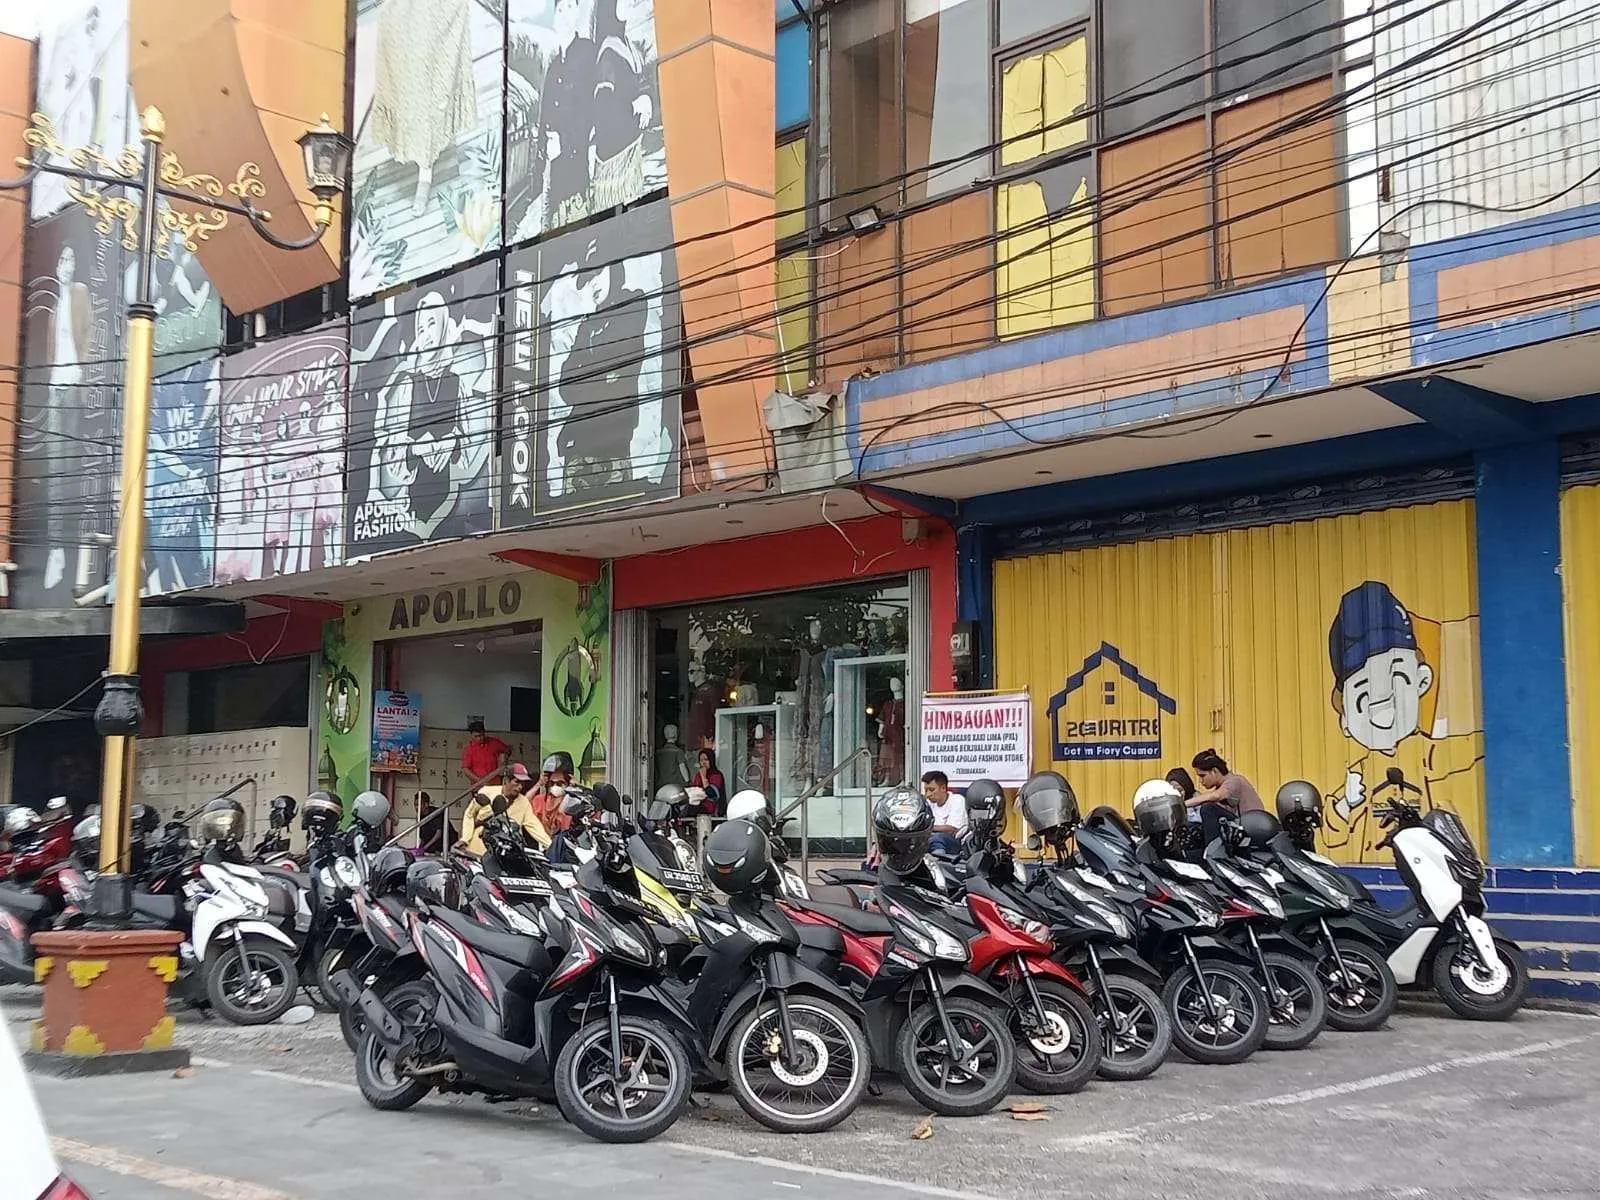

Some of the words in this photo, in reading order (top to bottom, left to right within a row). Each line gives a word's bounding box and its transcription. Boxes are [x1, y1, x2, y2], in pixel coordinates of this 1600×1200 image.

[512, 268, 535, 372] NEW
[166, 402, 196, 428] WE
[354, 498, 411, 523] APOLLO
[354, 510, 416, 541] FASHION
[389, 580, 522, 631] APOLLO
[377, 706, 410, 716] LANTAI
[924, 708, 1023, 730] HIMBAUAN!!!
[936, 744, 958, 752] LARANG
[1000, 743, 1015, 751] AREA
[987, 733, 1001, 741] LIMA
[922, 755, 939, 763] TERAS
[940, 755, 955, 763] TOKO
[956, 754, 977, 762] APOLLO
[978, 754, 1003, 762] FASHION
[1004, 753, 1024, 762] STORE
